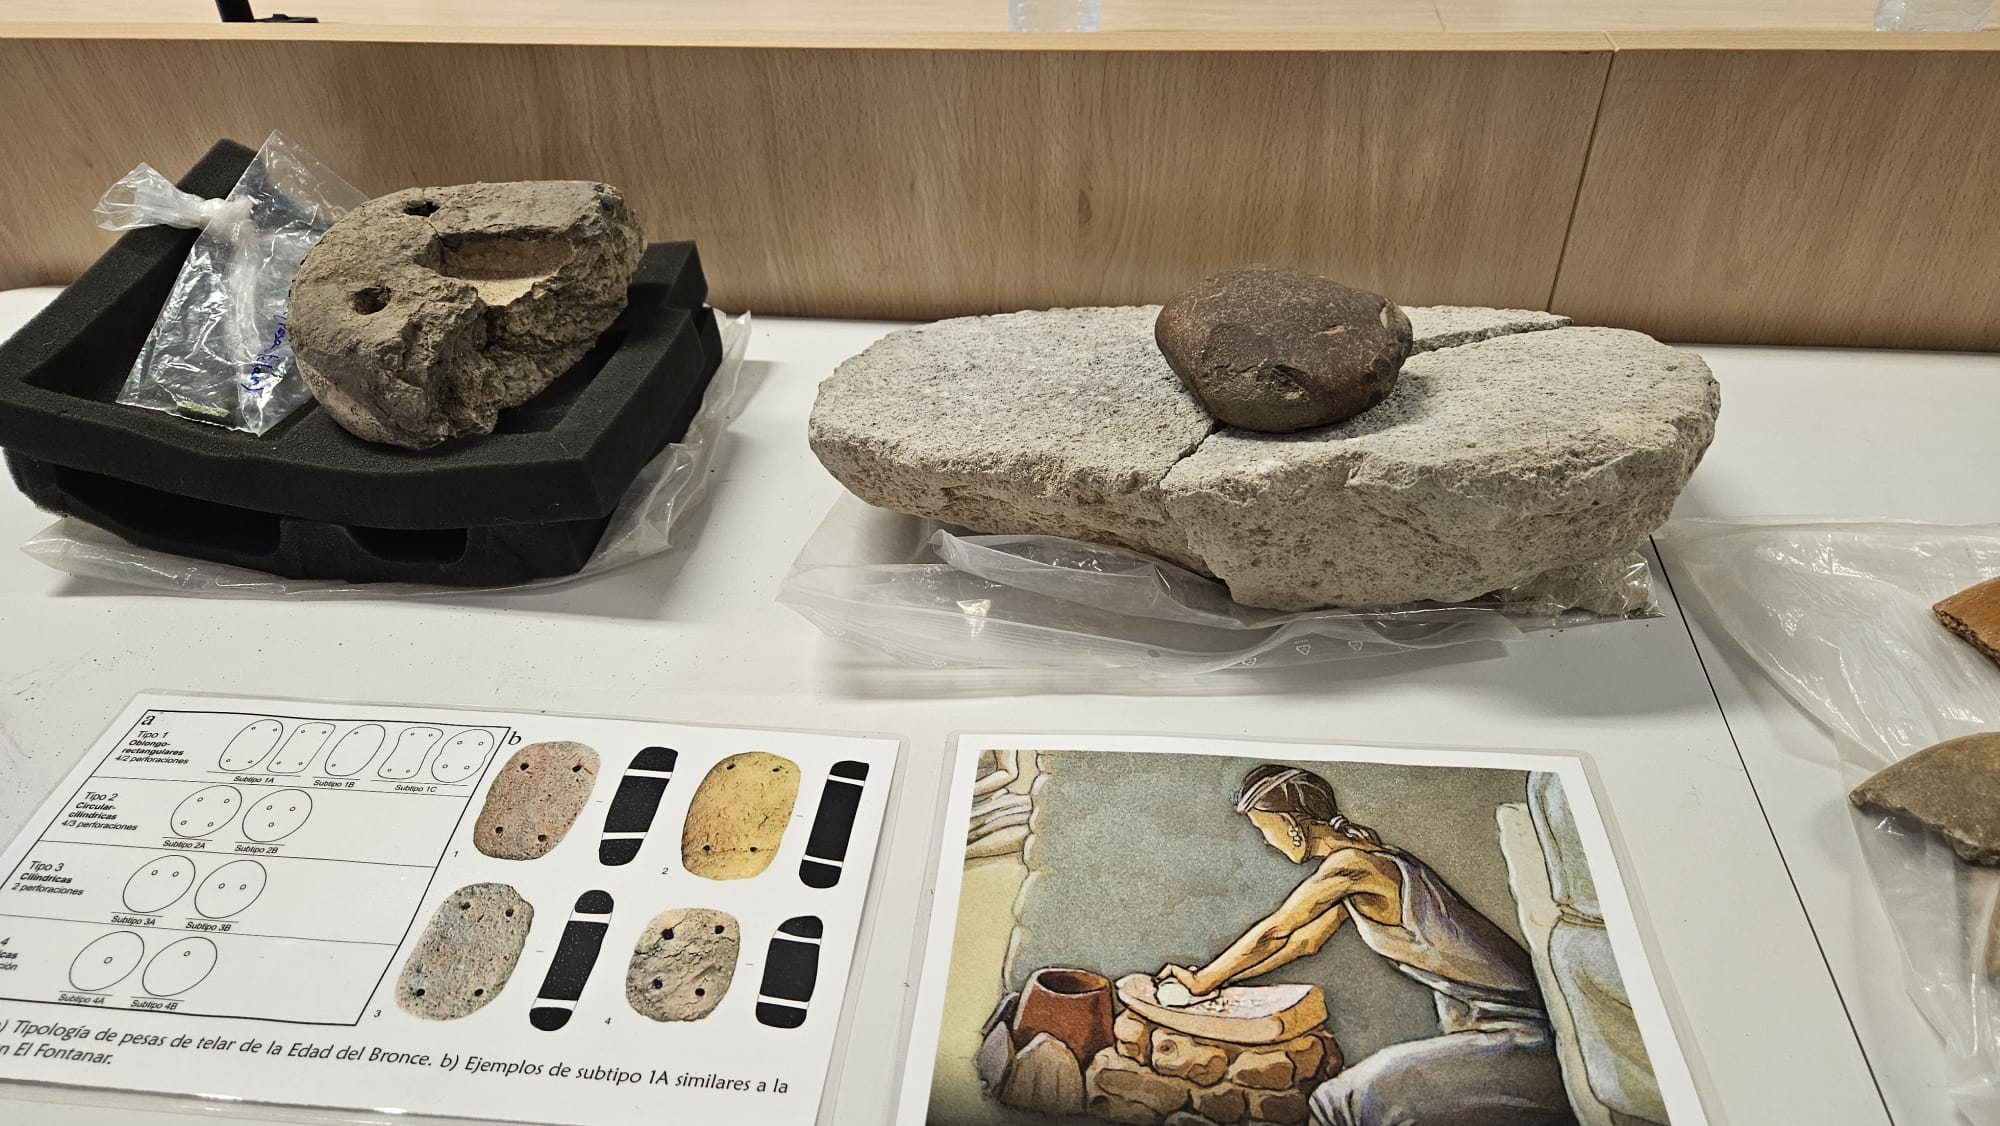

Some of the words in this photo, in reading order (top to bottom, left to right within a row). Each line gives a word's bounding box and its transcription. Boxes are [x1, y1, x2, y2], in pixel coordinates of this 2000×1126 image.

[141, 715, 155, 726] a
[137, 731, 158, 739] Tipo
[508, 731, 522, 745] b
[129, 756, 189, 764] perforaciones
[313, 780, 342, 788] Subtipo
[395, 784, 424, 792] Subtipo
[426, 785, 437, 793] 1C
[85, 791, 107, 801] Tipo
[108, 793, 118, 801] 2
[76, 802, 116, 810] Circular-
[76, 821, 138, 830] perforaciones
[163, 840, 192, 848] Subtipo
[235, 844, 265, 854] Subtipo
[30, 861, 53, 871] Tipo
[55, 862, 64, 871] 3
[661, 867, 669, 875] 2
[19, 884, 84, 895] perforaciones
[111, 915, 142, 925] Subtipo
[143, 918, 156, 926] 3A
[185, 921, 217, 932] Subtipo
[58, 993, 91, 1003] Subtipo
[130, 999, 163, 1009] Subtipo
[165, 1002, 178, 1010] 4B
[373, 1009, 382, 1018] 3
[604, 1016, 611, 1025] 4
[13, 1042, 34, 1056] El
[33, 1043, 113, 1065] Fontanar.
[13, 1020, 91, 1041] Tipología
[94, 1027, 118, 1042] de
[117, 1033, 168, 1047] pesas
[170, 1034, 193, 1048] de
[196, 1035, 236, 1050] telar
[239, 1038, 263, 1053] de
[266, 1040, 283, 1055] la
[287, 1042, 334, 1059] Edad
[336, 1045, 366, 1061] del
[368, 1047, 432, 1066] Bronce.
[440, 1053, 459, 1071] b)
[464, 1056, 544, 1077] Ejemplos
[548, 1062, 571, 1077] de
[575, 1065, 642, 1086] subtipo
[649, 1069, 668, 1085] 1A
[675, 1072, 751, 1091] similares
[756, 1081, 767, 1092] a
[773, 1078, 788, 1094] la
